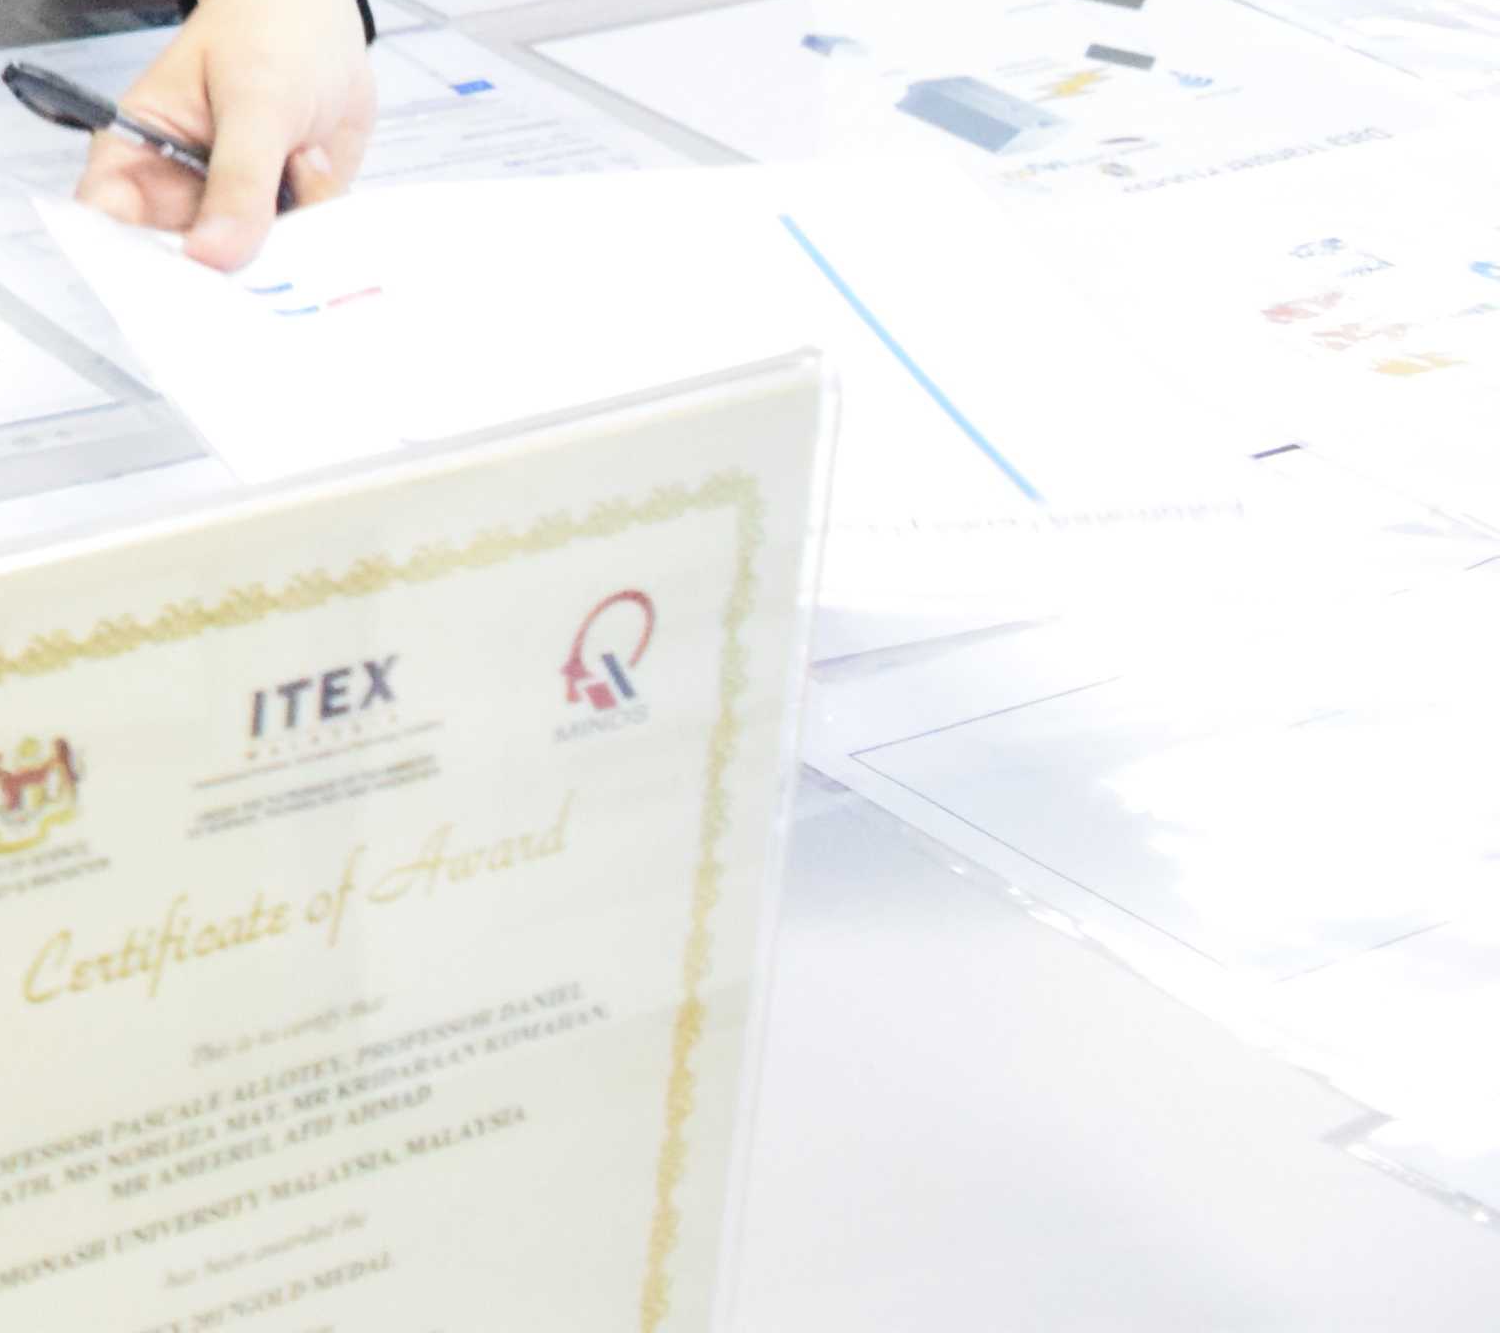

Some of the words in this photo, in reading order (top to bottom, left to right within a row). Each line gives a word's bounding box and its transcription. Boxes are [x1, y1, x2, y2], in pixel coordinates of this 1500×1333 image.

[248, 652, 400, 739] ITEX
[20, 889, 293, 1010] Certificate
[303, 841, 368, 949] of
[367, 788, 579, 904] Award
[107, 1088, 222, 1146] PASCALE
[354, 1005, 497, 1070] PROFESSOR
[108, 1185, 262, 1257] UNIVERSITY
[401, 1099, 530, 1163] MALAYSIA
